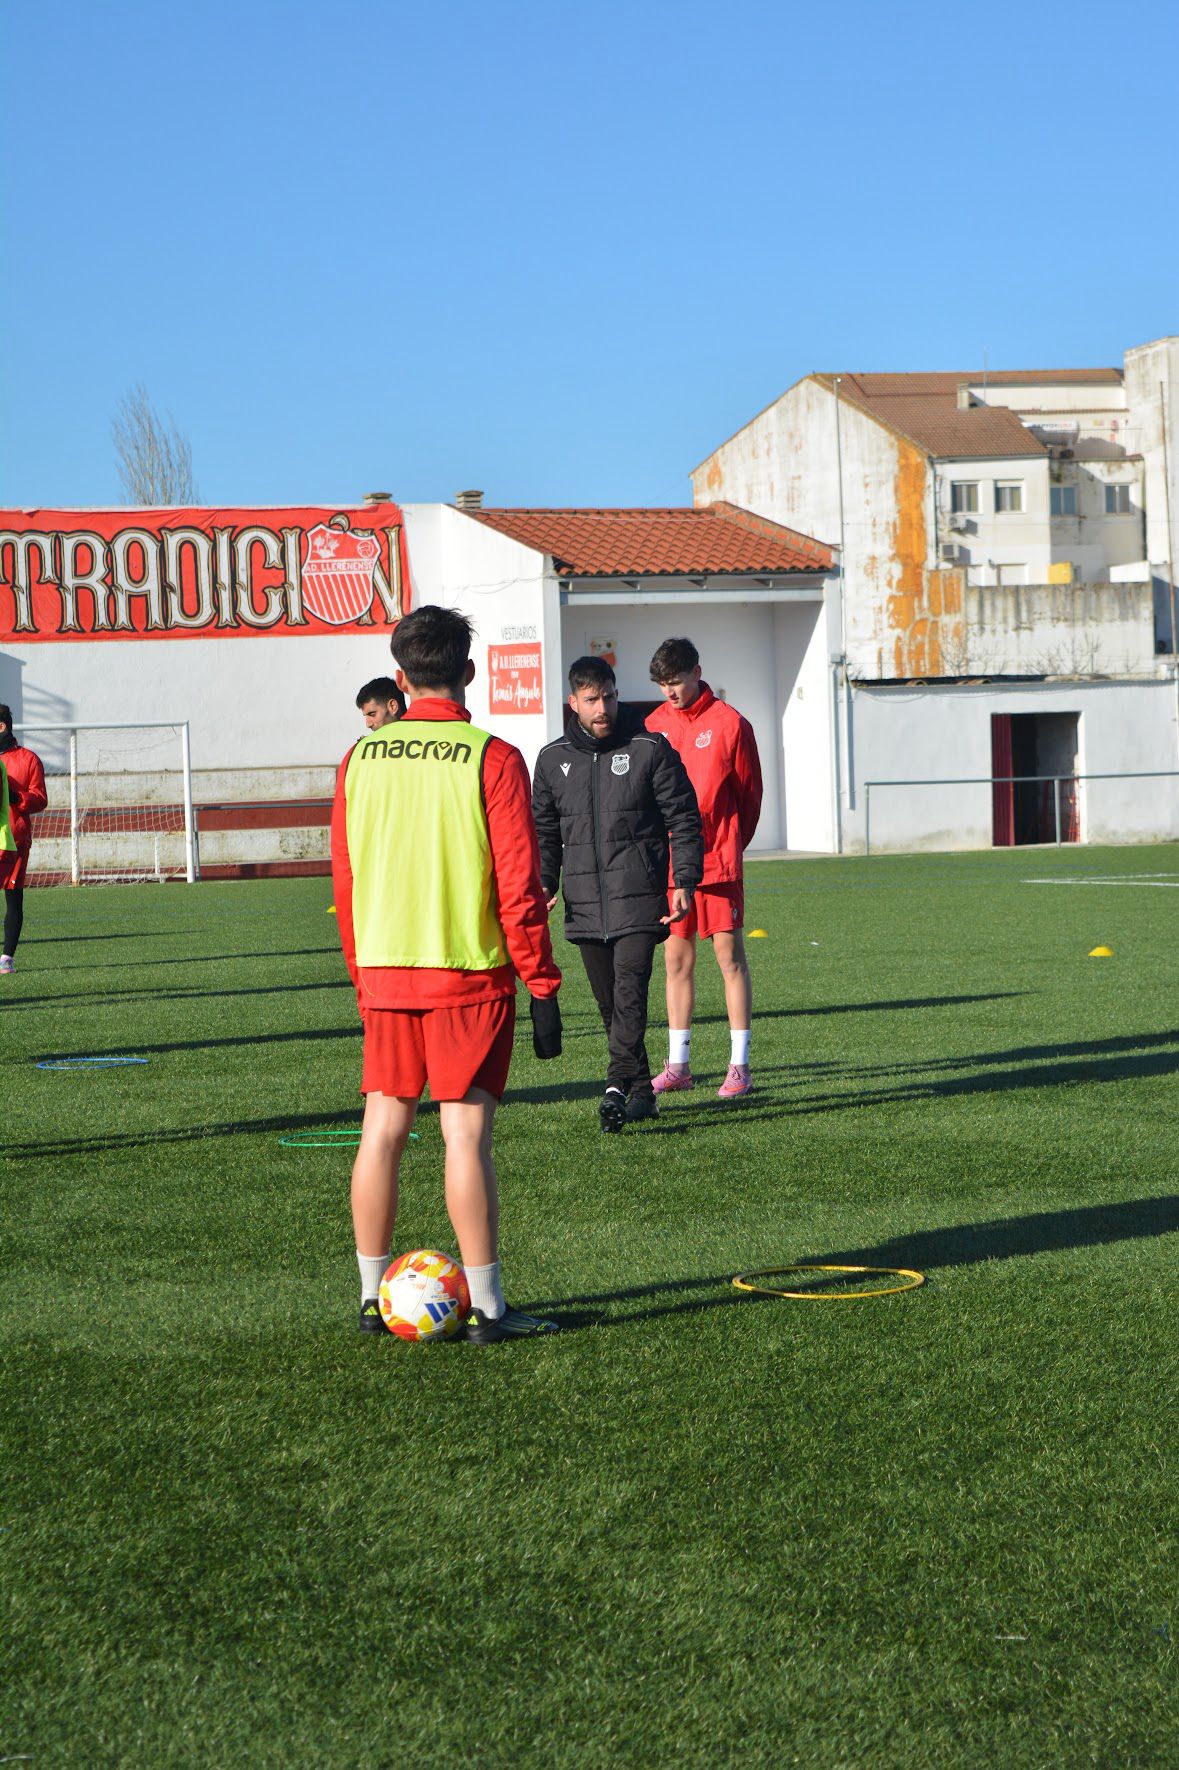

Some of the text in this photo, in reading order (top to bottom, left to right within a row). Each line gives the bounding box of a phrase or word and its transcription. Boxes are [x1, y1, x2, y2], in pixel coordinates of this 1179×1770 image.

[321, 561, 375, 573] LLERENENSE
[500, 625, 537, 640] VESTUARIOS
[361, 739, 472, 763] macron
